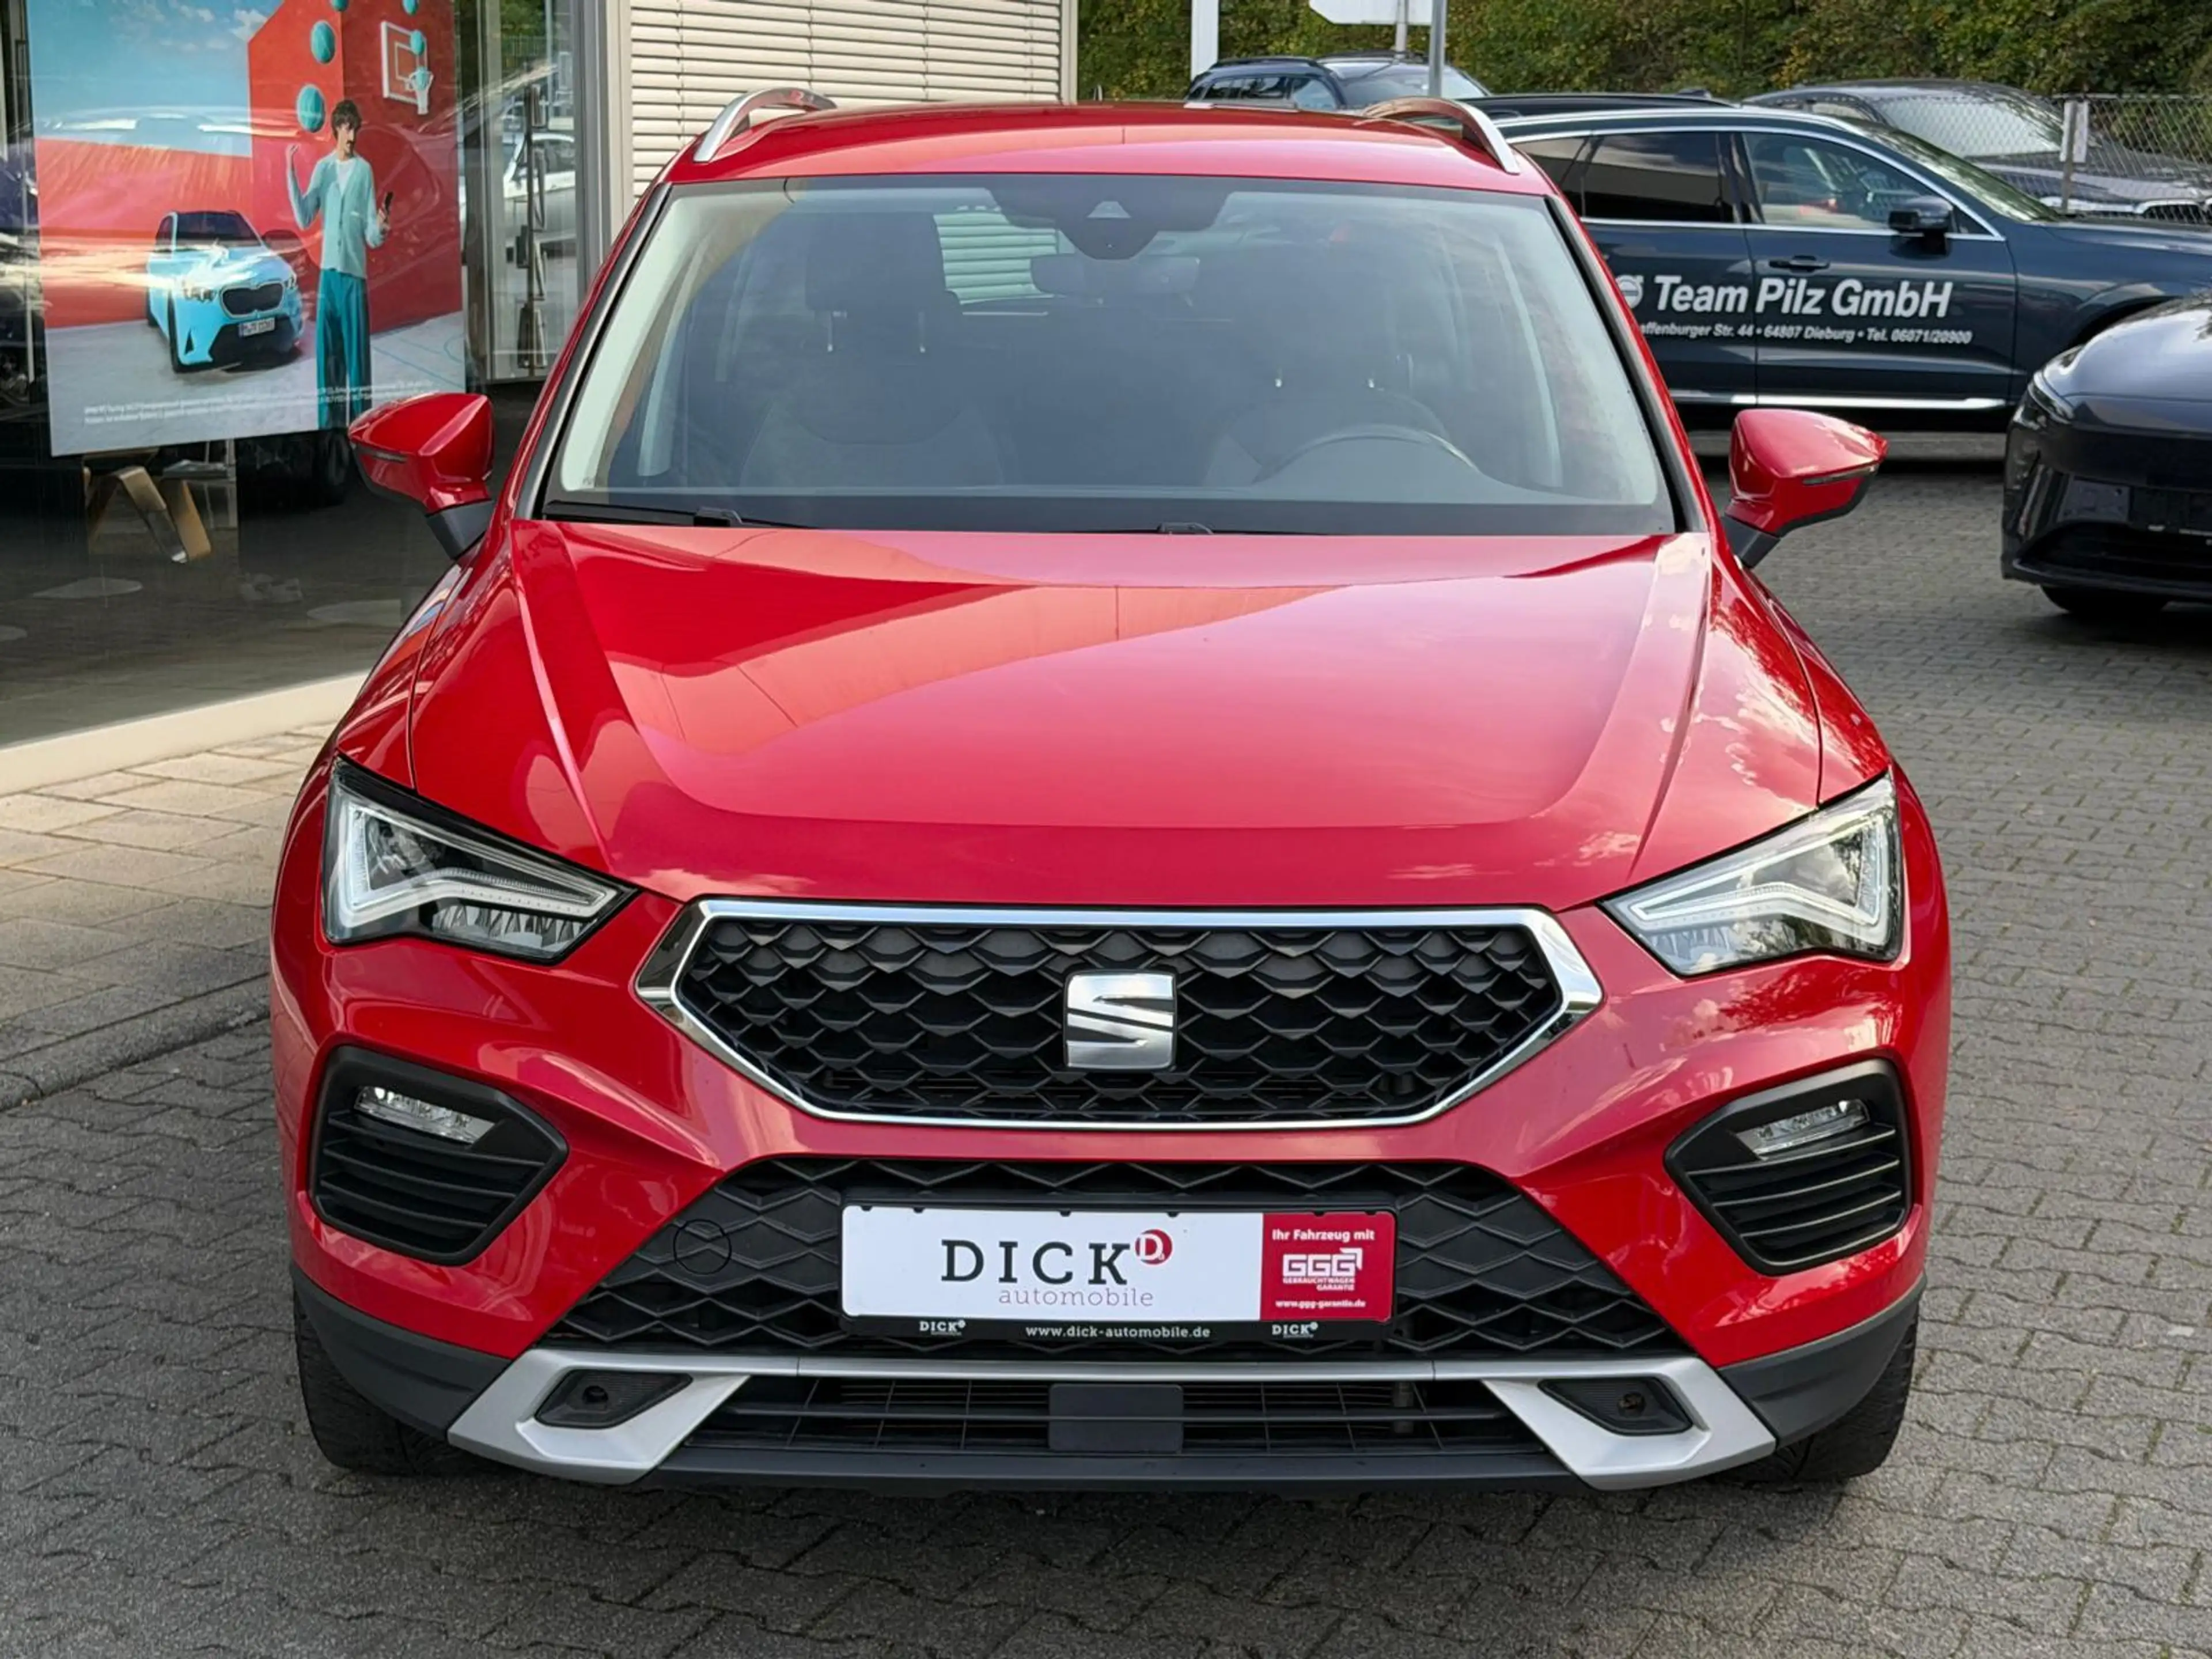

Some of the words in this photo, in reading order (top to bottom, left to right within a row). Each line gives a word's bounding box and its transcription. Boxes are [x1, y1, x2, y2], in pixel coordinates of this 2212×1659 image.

[1654, 275, 1749, 312] Team
[1755, 278, 1825, 315] Pilz
[1831, 279, 1953, 317] GmbH
[1641, 321, 1711, 338] affenburger
[1712, 324, 1734, 336] Str.
[1737, 324, 1753, 336] 44
[1804, 327, 1855, 343] Dieburg
[1866, 327, 1888, 342] Tel.
[1271, 1229, 1290, 1241] Ihr
[1293, 1229, 1350, 1243] Fahrzeug
[1354, 1229, 1375, 1241] mit
[941, 1240, 1130, 1285] DICK
[998, 1287, 1154, 1306] automobile
[919, 1320, 958, 1332] DICK
[1025, 1325, 1211, 1338] www.dick-automobile.de
[1271, 1324, 1311, 1336] DICK
